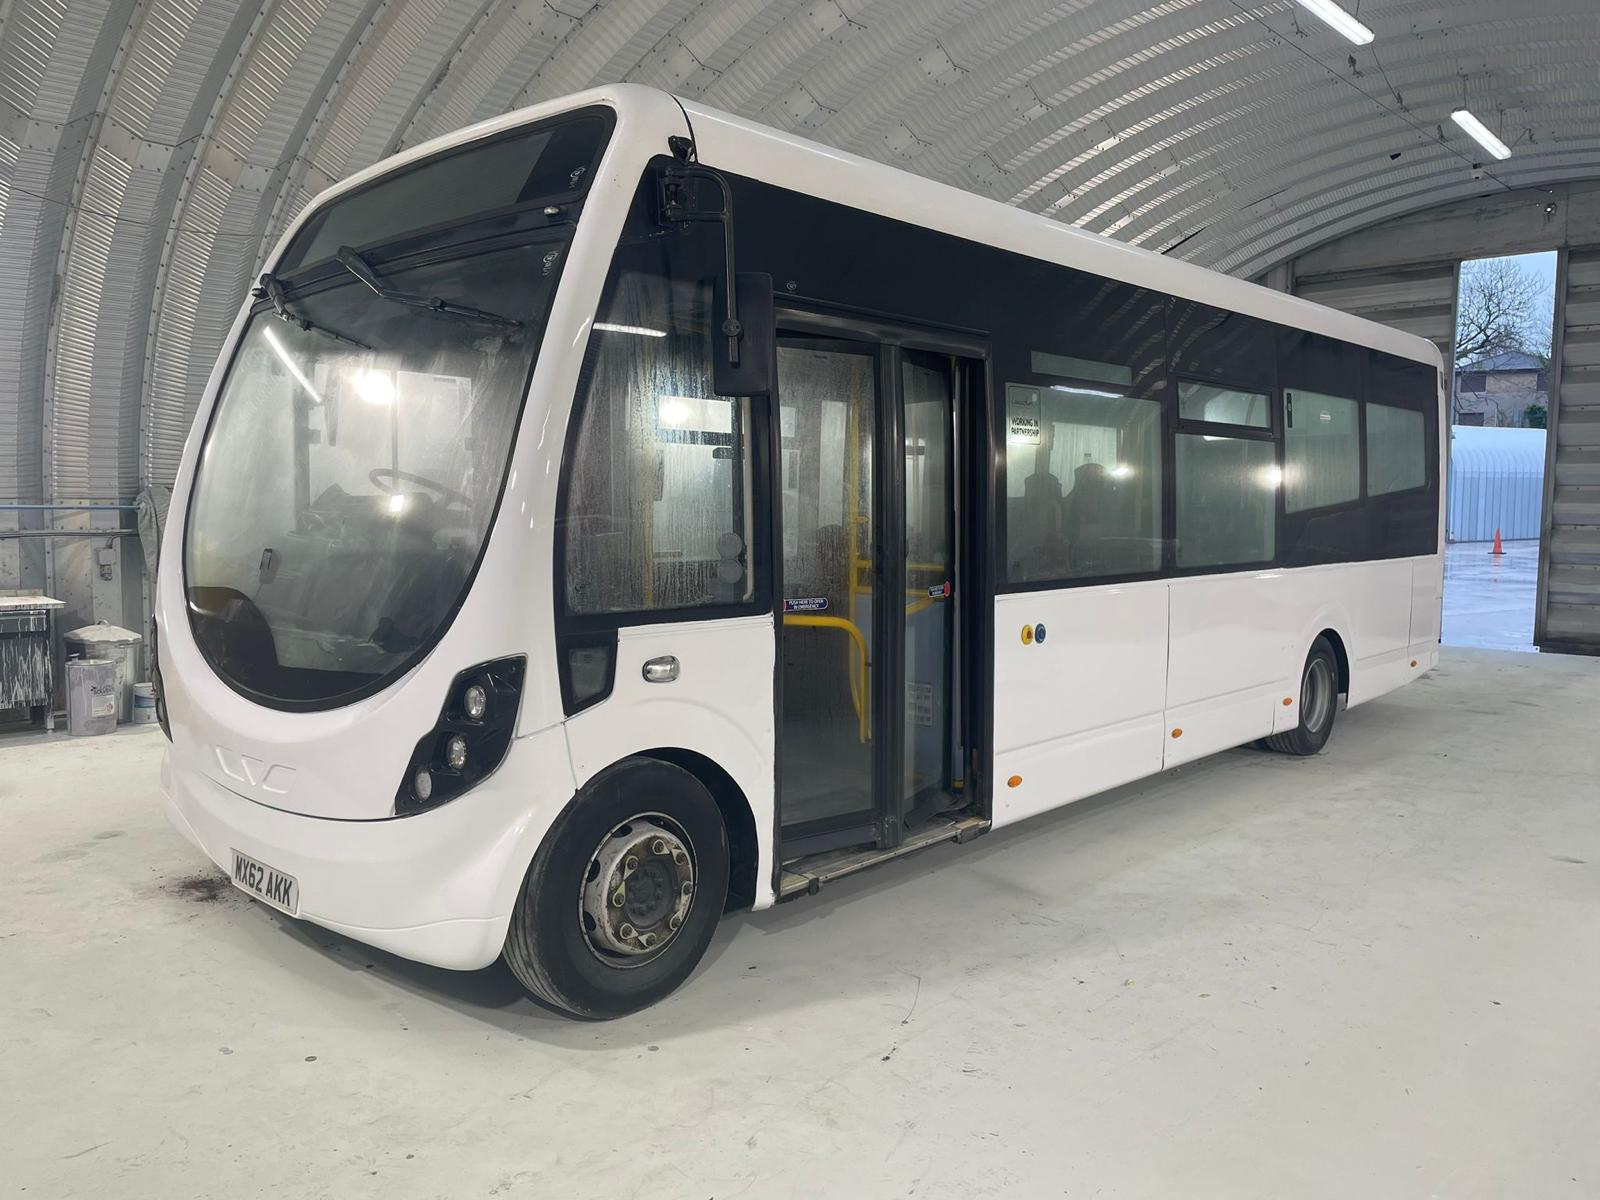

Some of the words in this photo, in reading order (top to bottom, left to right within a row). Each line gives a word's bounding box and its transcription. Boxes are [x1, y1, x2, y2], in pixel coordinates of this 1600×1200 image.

[1011, 417, 1033, 427] WORKING
[1034, 419, 1039, 427] IN
[1011, 427, 1039, 437] PARTNERSHIP
[235, 855, 264, 893] MX62
[266, 871, 292, 907] AKK
